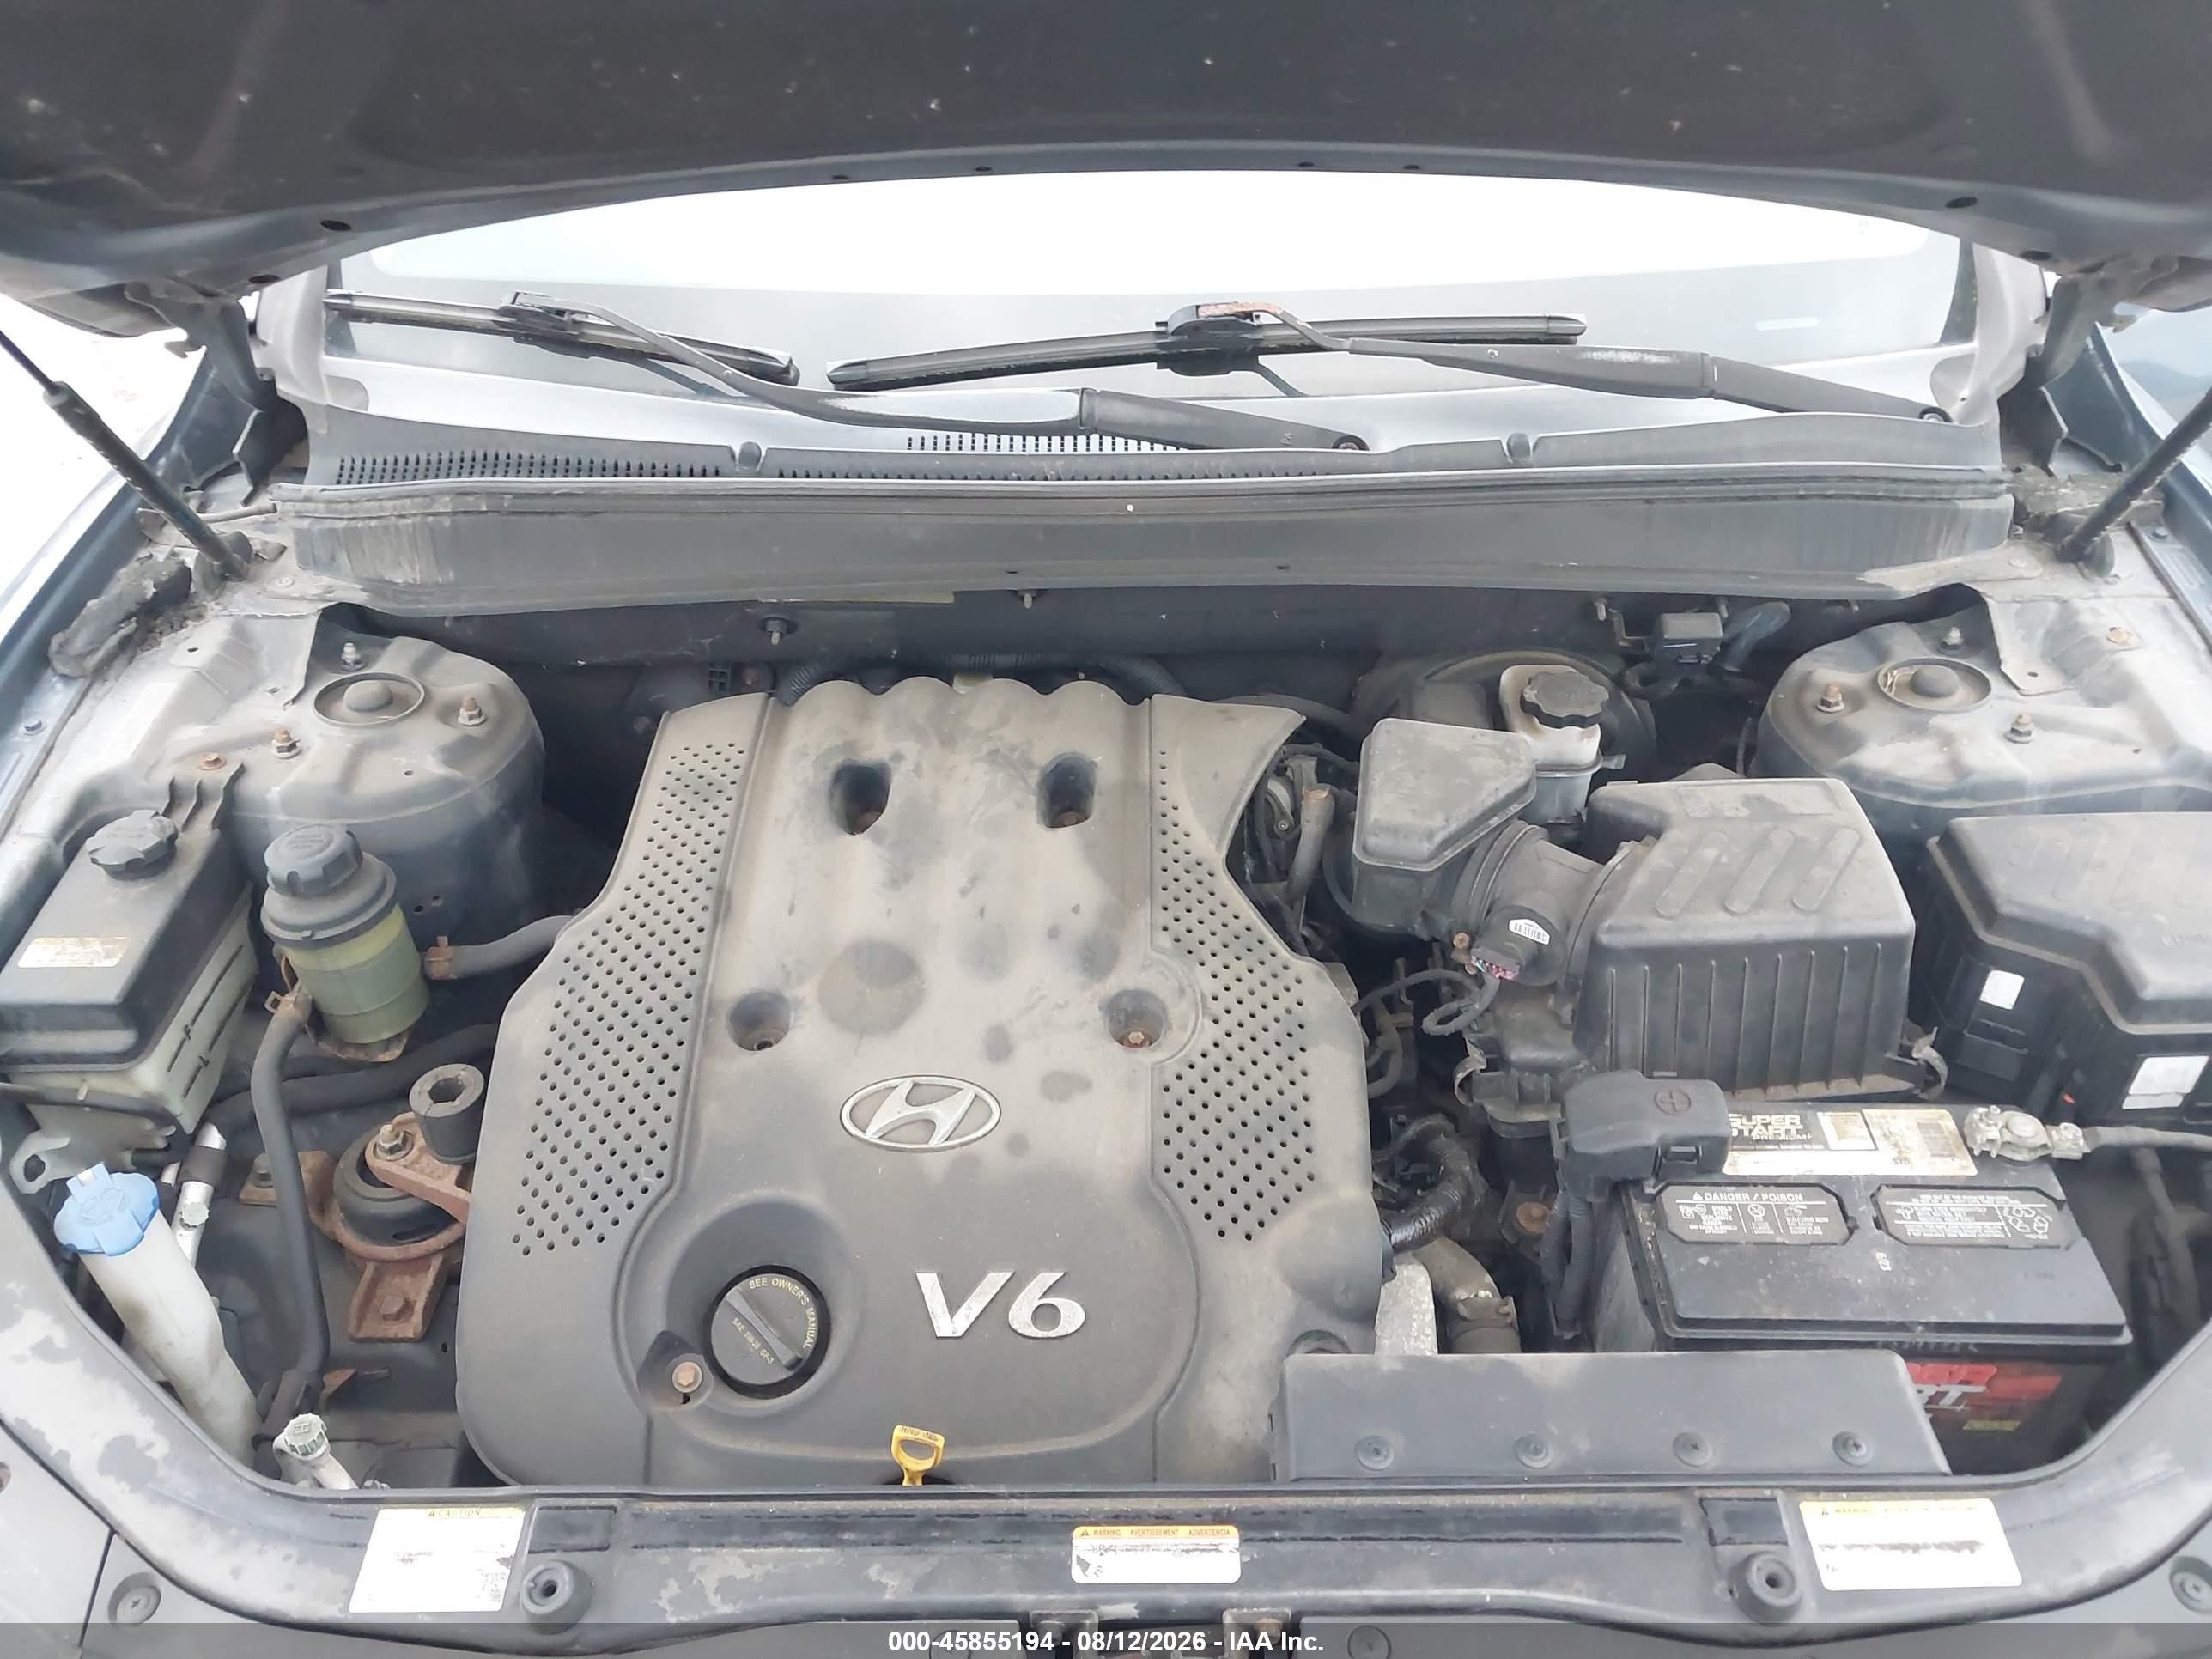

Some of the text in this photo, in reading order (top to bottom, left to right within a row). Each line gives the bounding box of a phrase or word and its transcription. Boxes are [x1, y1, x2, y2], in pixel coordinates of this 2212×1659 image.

[1704, 1192, 1749, 1201] DANGER
[1761, 1193, 1803, 1202] POISON
[749, 1277, 818, 1348] SEE OWNER'S MANUAL
[915, 1272, 1085, 1338] V6
